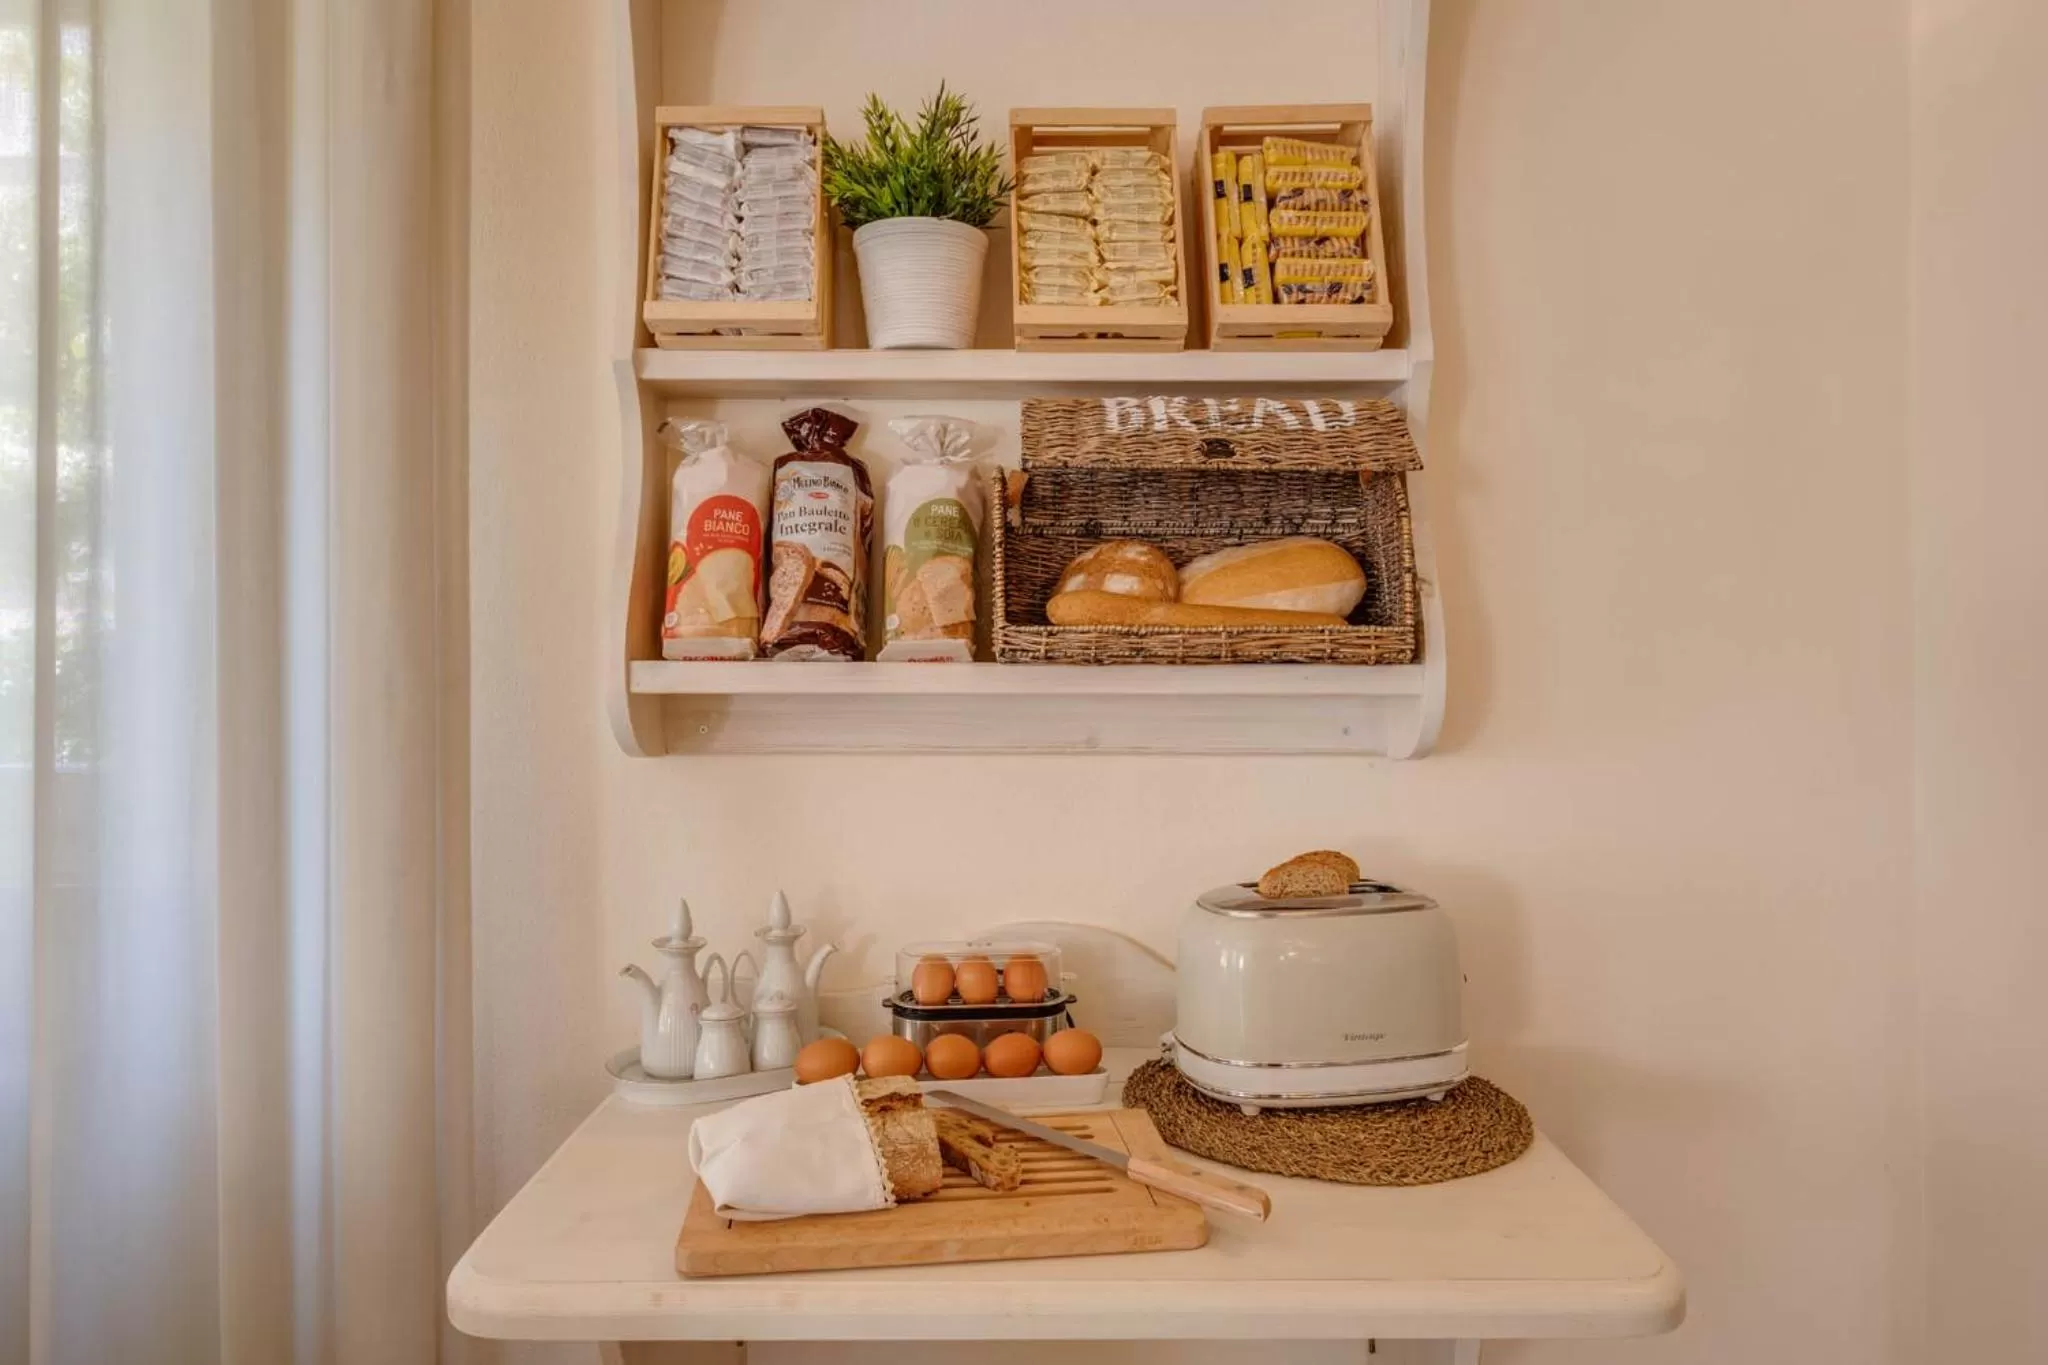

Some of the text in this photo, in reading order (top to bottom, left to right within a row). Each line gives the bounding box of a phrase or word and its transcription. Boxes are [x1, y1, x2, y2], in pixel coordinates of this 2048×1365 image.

[1102, 396, 1356, 432] BREAD
[713, 508, 744, 523] PANE
[777, 505, 850, 522] Pan Bauletto
[930, 504, 959, 518] PANE
[704, 519, 750, 536] BIANCO
[780, 519, 847, 536] Integrale
